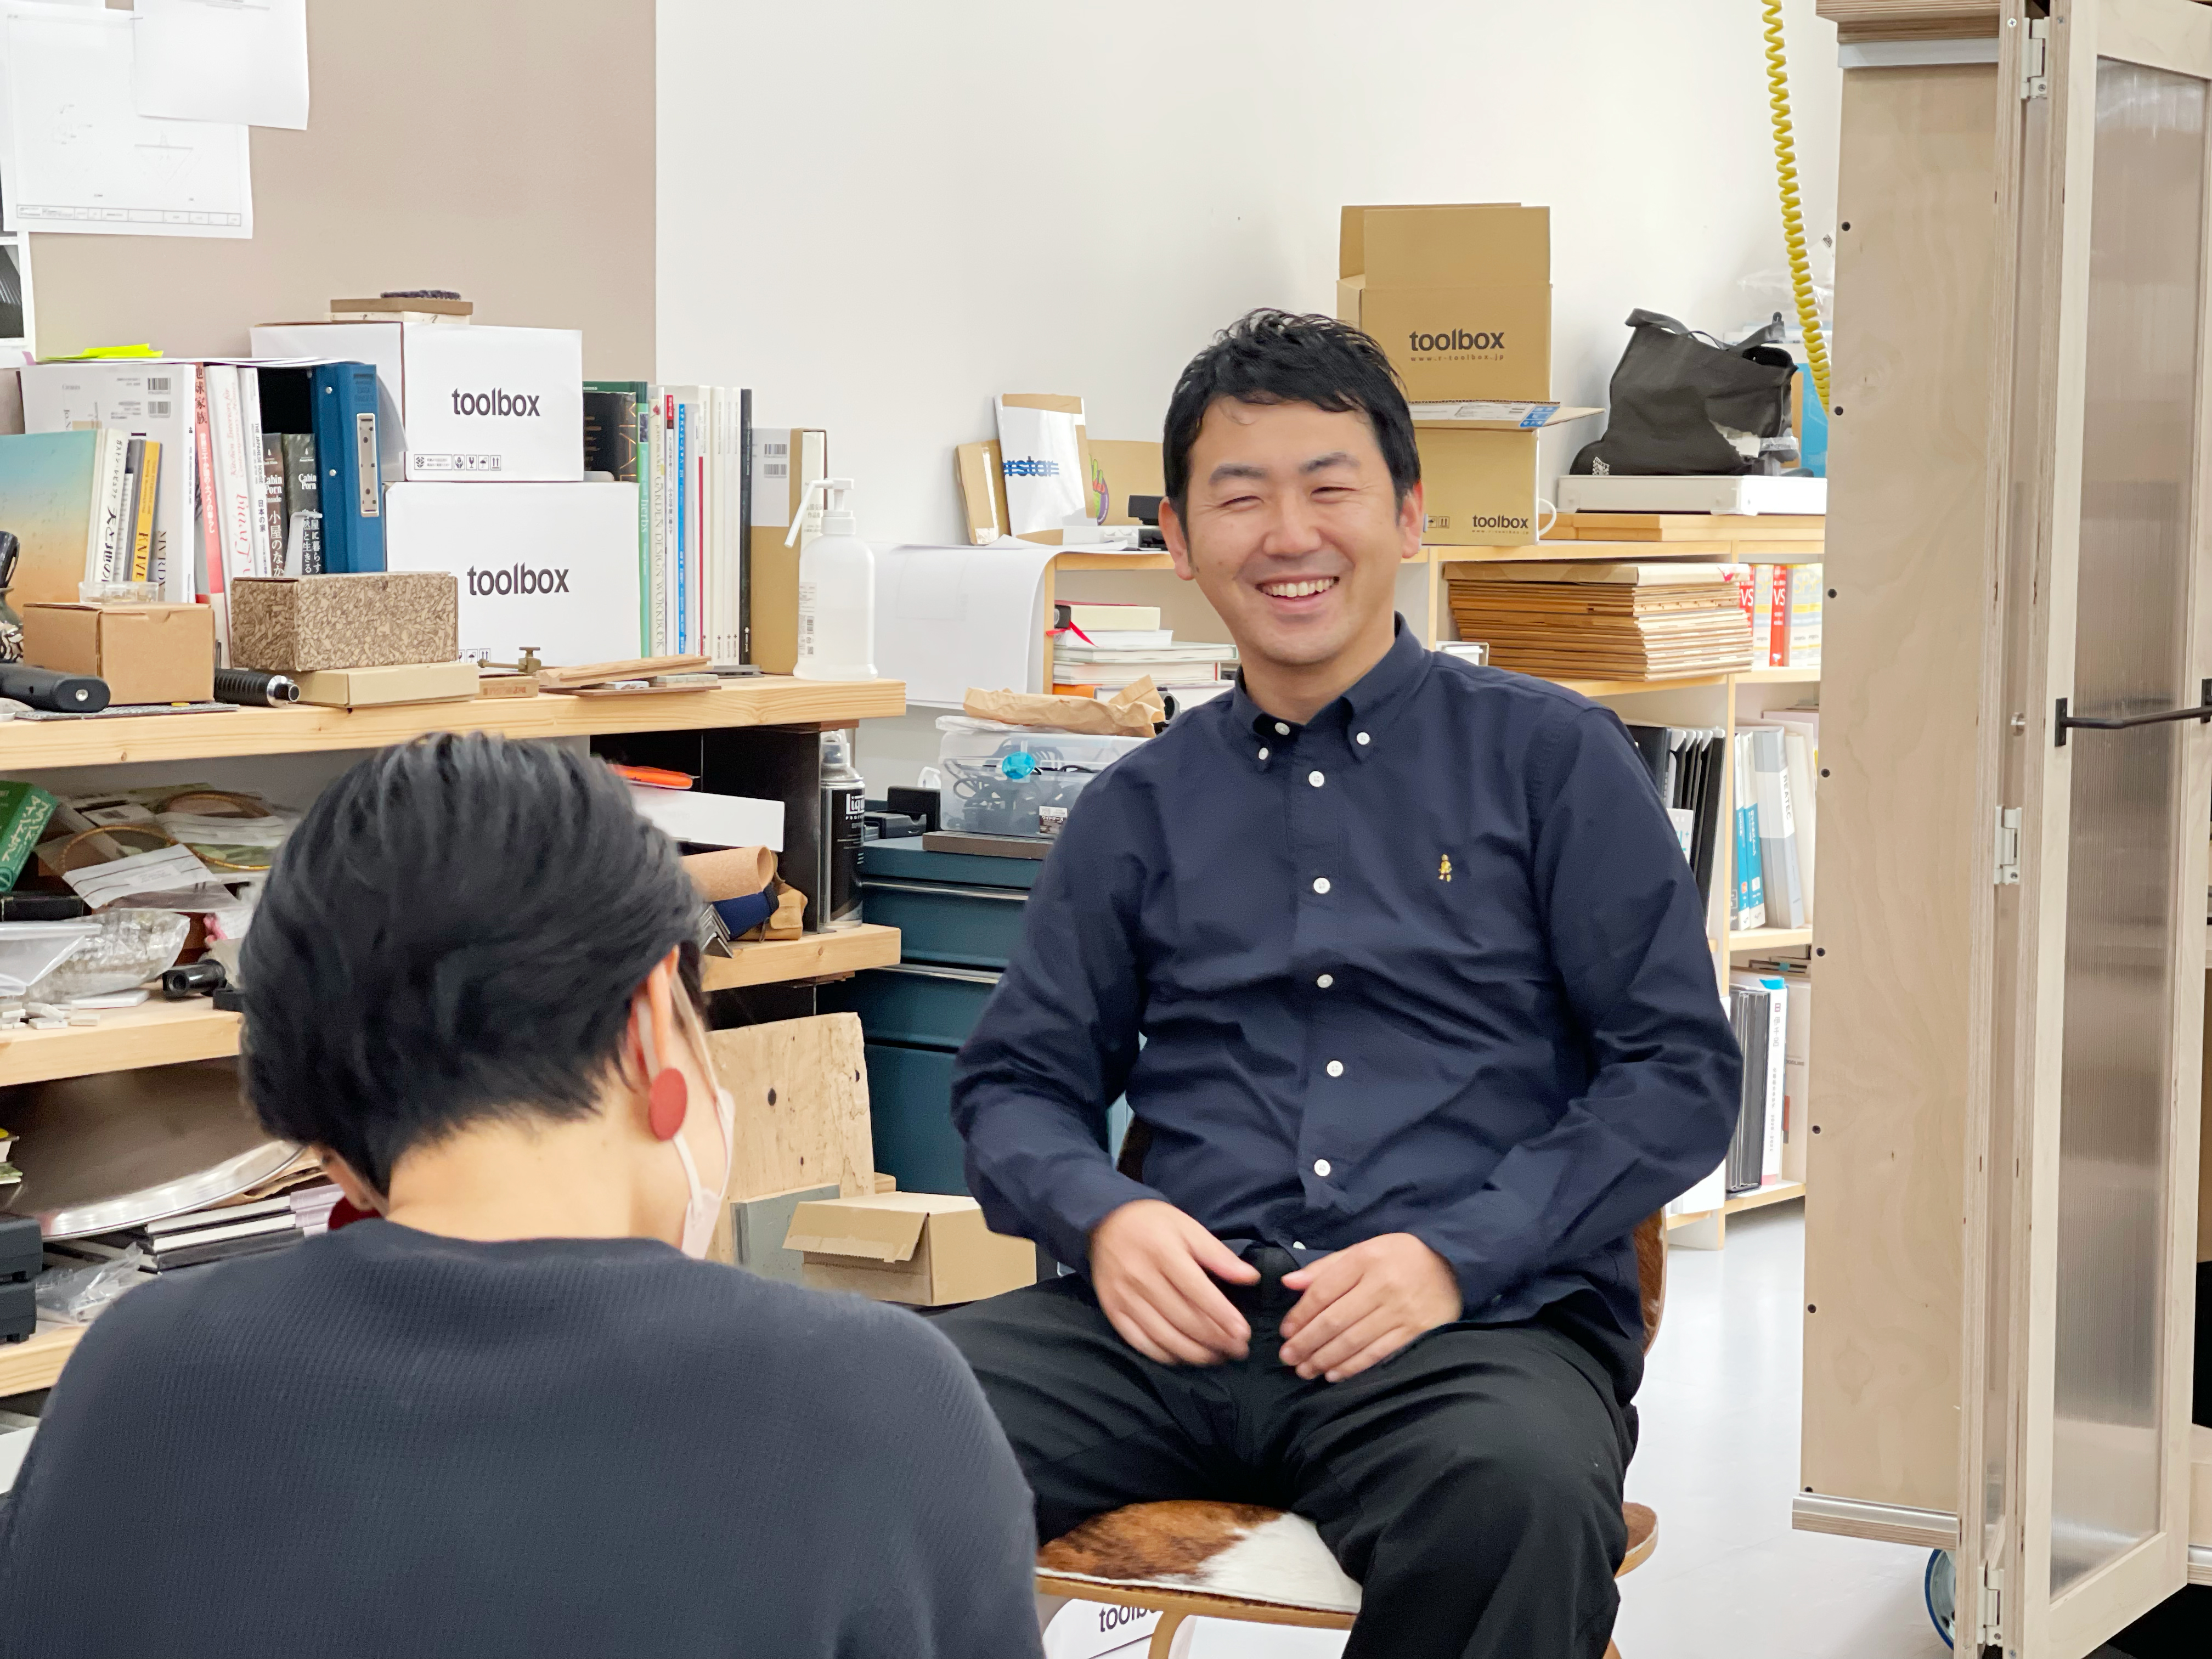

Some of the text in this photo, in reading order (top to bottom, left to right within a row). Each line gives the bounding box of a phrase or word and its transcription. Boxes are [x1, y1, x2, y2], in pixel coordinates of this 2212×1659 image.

[1409, 328, 1505, 351] toolbox
[451, 387, 540, 416] toolbox
[298, 473, 317, 483] Cabin
[1003, 456, 1059, 476] rstar
[265, 485, 283, 494] Porn
[641, 499, 649, 533] herbs
[1472, 514, 1529, 528] toolbox
[268, 510, 284, 577] 小屋のなか
[654, 476, 664, 649] GARDEN DESIGN WORKBOOK
[467, 562, 569, 595] toolbox
[1783, 775, 1791, 820] REATEC
[1099, 1605, 1158, 1632] tool
